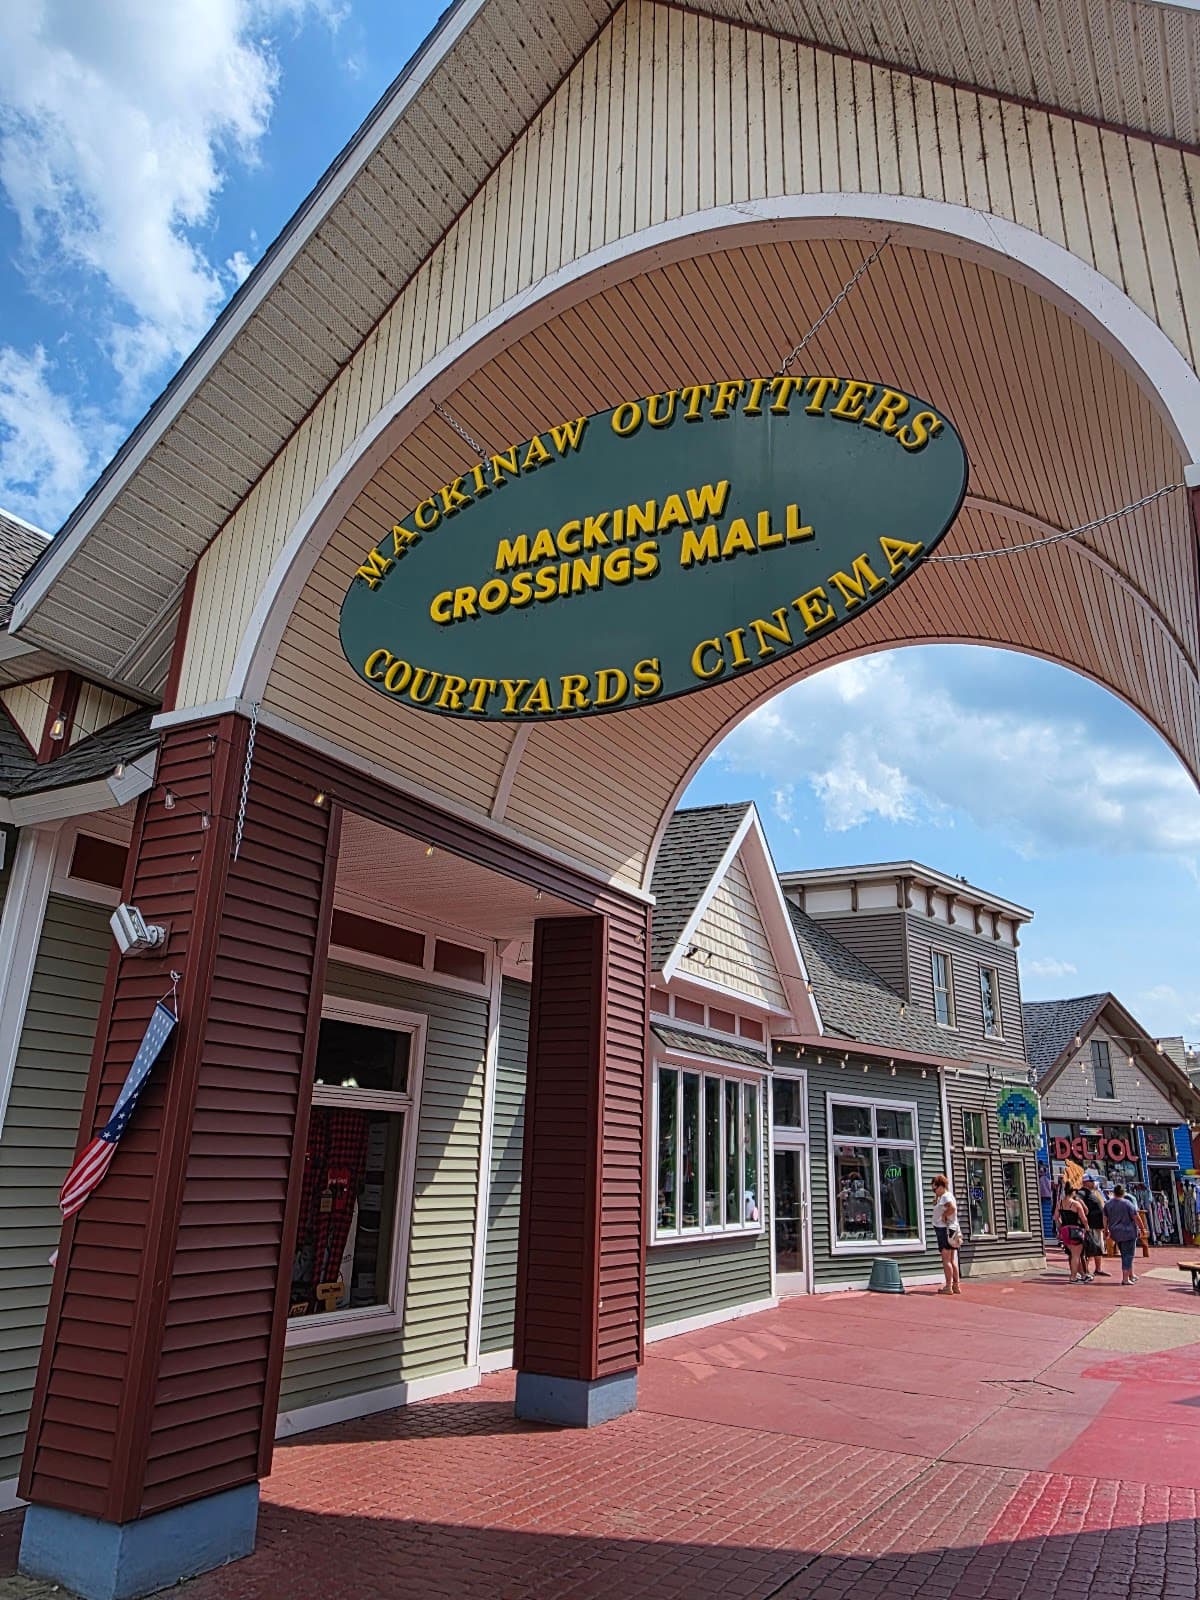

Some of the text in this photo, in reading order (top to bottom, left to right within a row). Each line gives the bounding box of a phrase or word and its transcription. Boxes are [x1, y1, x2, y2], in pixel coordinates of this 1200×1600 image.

[356, 376, 943, 590] MACKINAW OUTFITTERS
[494, 480, 730, 573] MACKINAW
[429, 503, 816, 625] CROSSINGS MALL
[362, 535, 923, 715] COURTYARDS CINEMA
[884, 1167, 902, 1178] ATM
[1054, 1136, 1095, 1160] DEL
[1095, 1138, 1138, 1162] SOL
